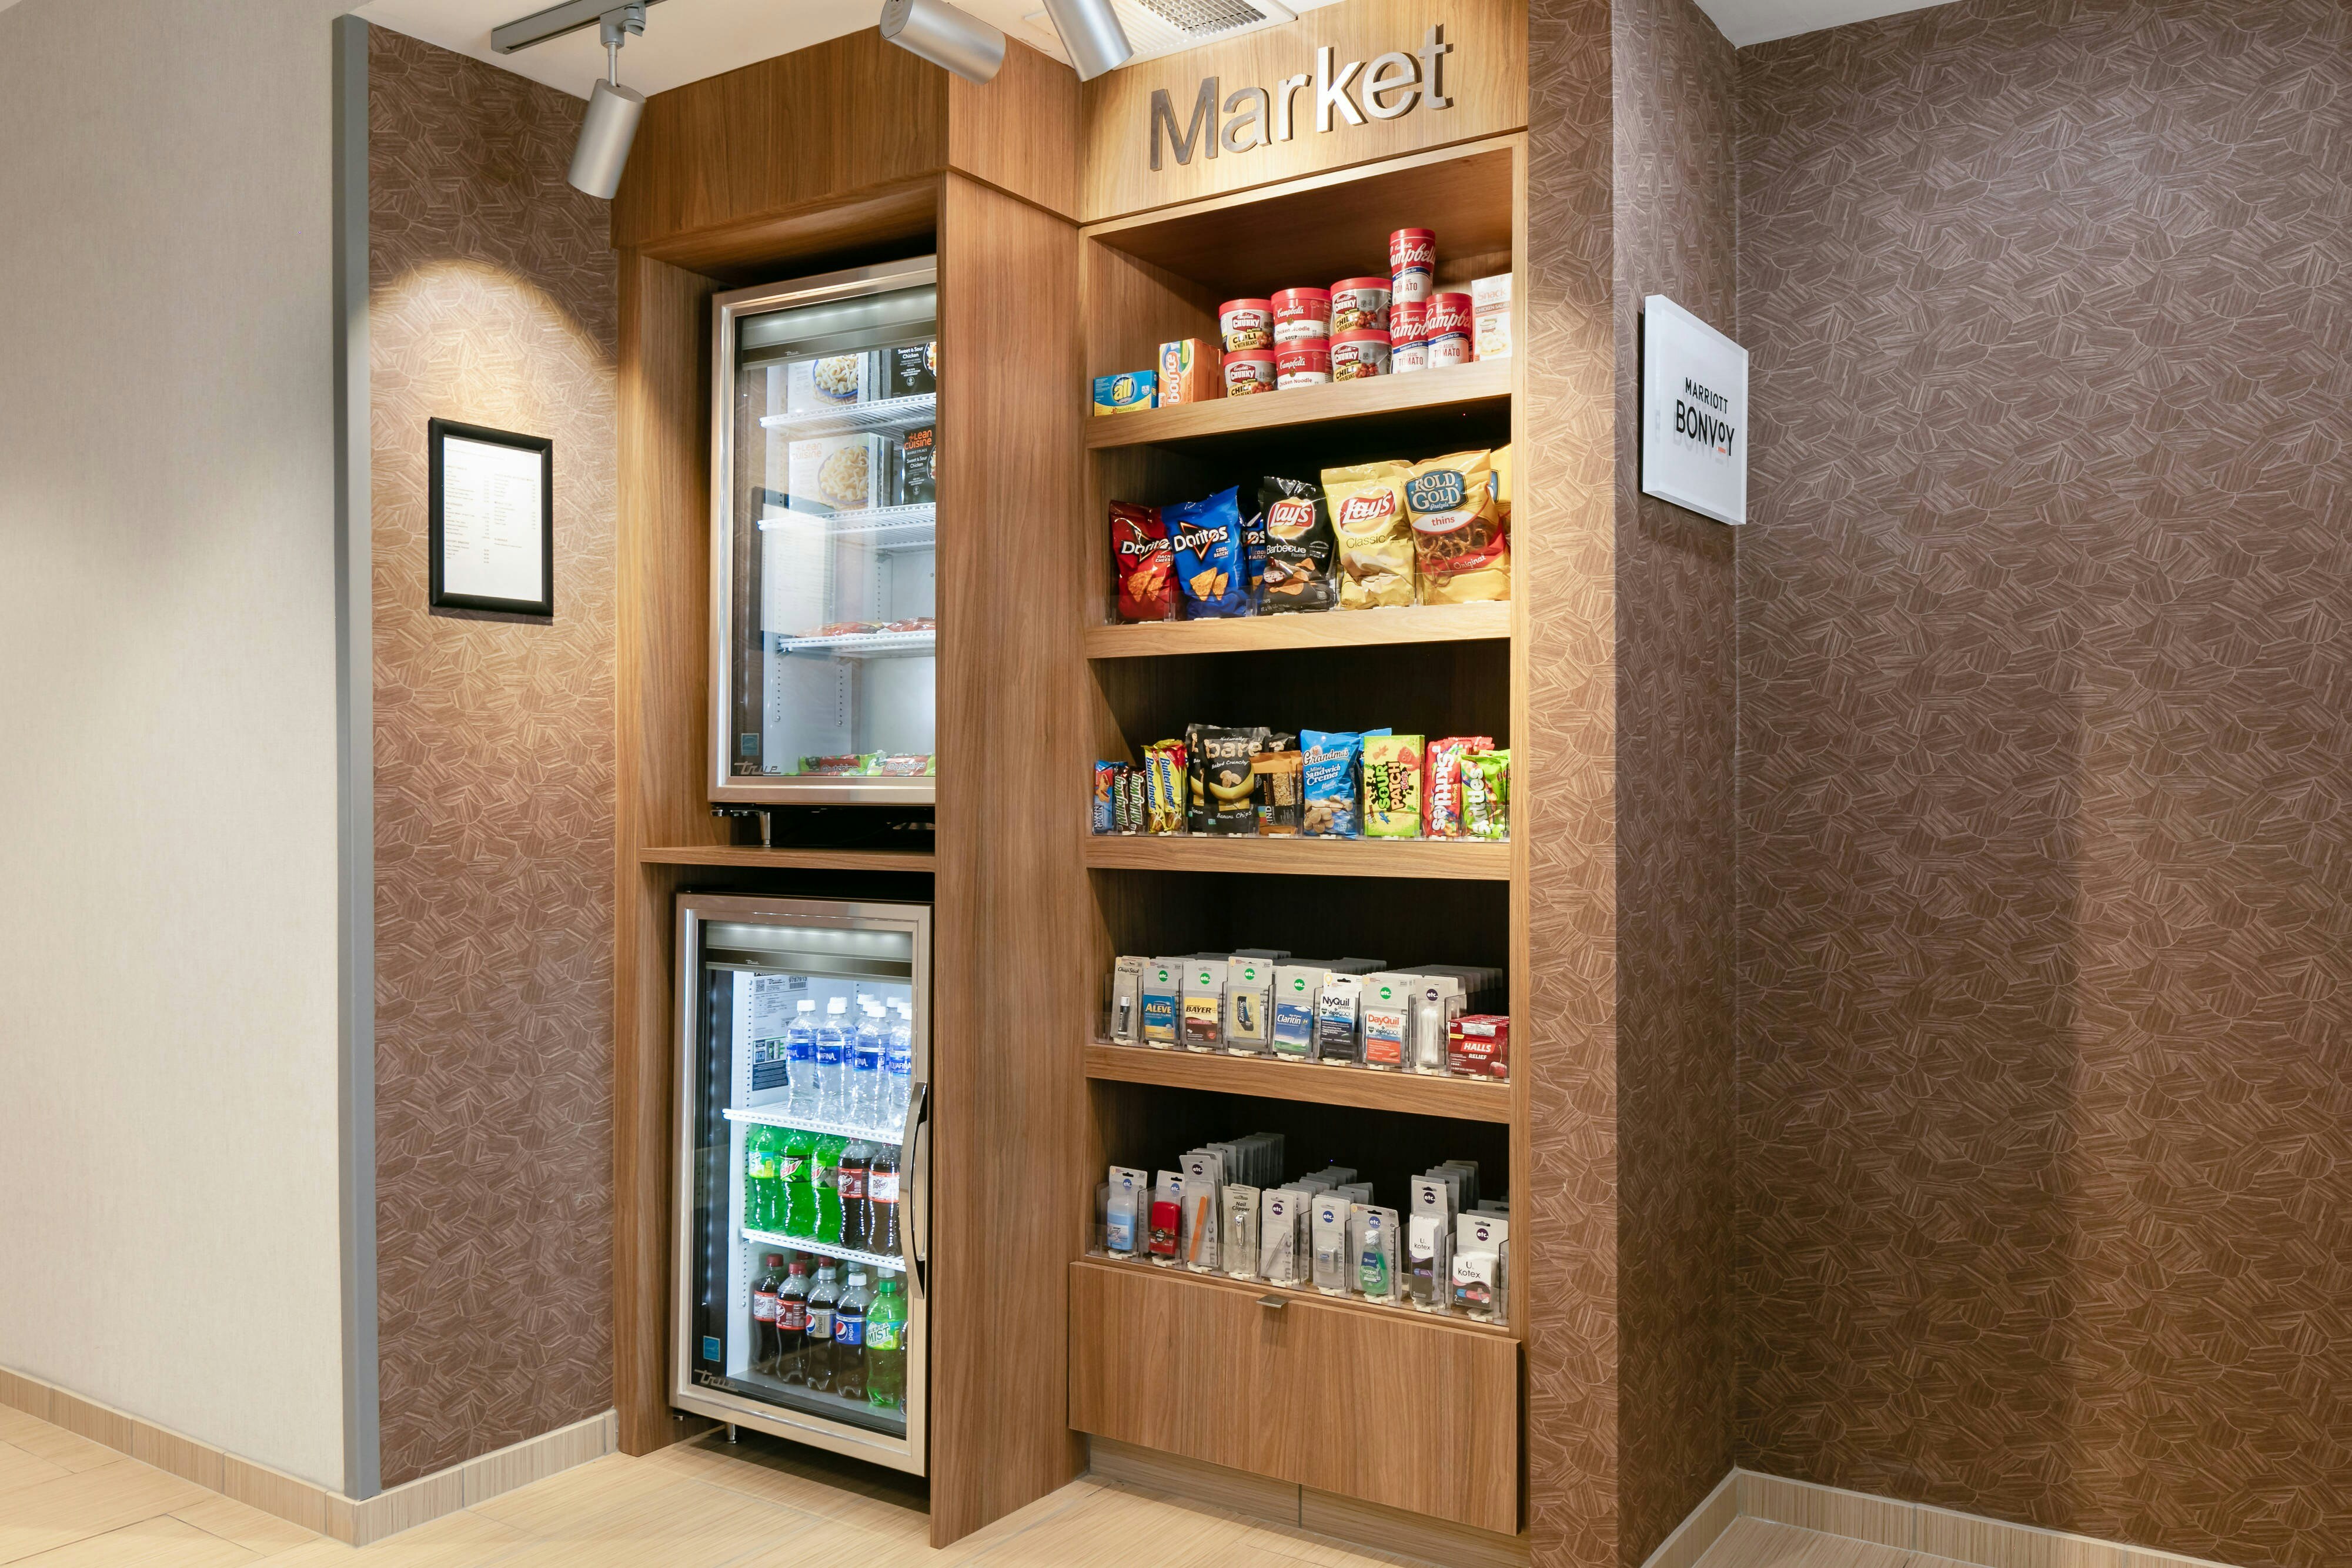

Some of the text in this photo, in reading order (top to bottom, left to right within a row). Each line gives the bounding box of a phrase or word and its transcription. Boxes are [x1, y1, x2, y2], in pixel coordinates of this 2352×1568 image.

[1150, 24, 1454, 171] Market
[1335, 299, 1357, 312] CHUNKY
[1232, 319, 1259, 329] CHUNKY
[1335, 351, 1358, 361] CHUNKY
[1167, 351, 1181, 404] bounce
[1231, 370, 1254, 379] CHUNKY
[1114, 377, 1133, 400] all
[1685, 377, 1728, 414] MARRIOTT
[914, 430, 932, 440] Lean
[1676, 399, 1735, 456] BONVOY
[1415, 472, 1455, 492] ROLD
[1412, 487, 1461, 510] GOLD
[1430, 502, 1449, 510] Pretzels
[1342, 494, 1392, 524] Lay's
[1431, 516, 1455, 526] thins
[1174, 526, 1228, 551] Doritos
[1346, 535, 1385, 549] Classic
[1267, 544, 1307, 554] Barbecue
[1454, 553, 1486, 570] Original
[1204, 739, 1262, 758] bare
[1303, 748, 1349, 765] Grandma's
[1212, 761, 1225, 769] Baked
[1305, 764, 1341, 778] Sandwich
[1145, 757, 1157, 810] Butterfinger
[1160, 757, 1175, 810] Butterfinger
[1307, 771, 1338, 786] Cremes
[1375, 764, 1391, 809] SOUR
[1388, 761, 1405, 811] PATCH
[1401, 771, 1409, 790] Kids
[1432, 753, 1455, 830] Skittles
[1145, 1003, 1172, 1014] ALEVE
[1322, 997, 1349, 1007] NyQuil
[1277, 1014, 1301, 1024] Claritin
[1368, 1014, 1399, 1025] DayQuil
[1464, 1042, 1492, 1053] HALLS
[1458, 1268, 1481, 1279] kotex
[868, 1323, 888, 1333] SIERRA
[868, 1327, 890, 1344] MIST
